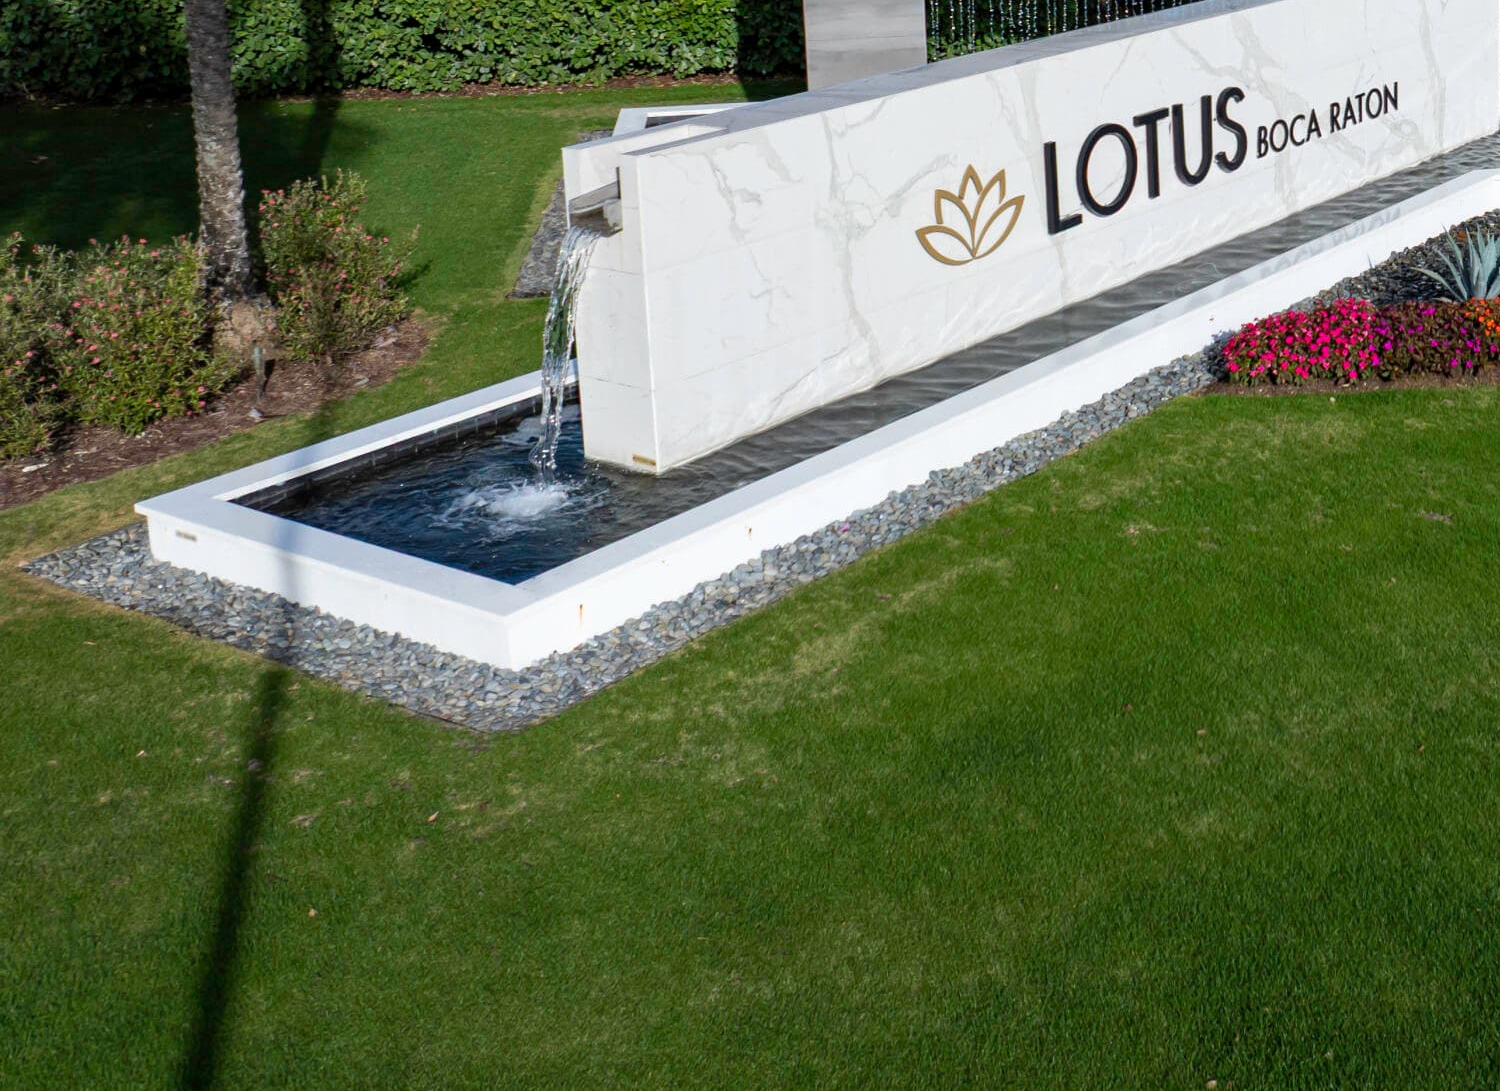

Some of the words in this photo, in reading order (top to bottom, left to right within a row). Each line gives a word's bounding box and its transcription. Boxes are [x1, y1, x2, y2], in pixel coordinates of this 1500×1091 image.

[1043, 86, 1248, 235] LOTUS
[1257, 108, 1322, 159] BOCA
[1329, 81, 1399, 134] RATON
